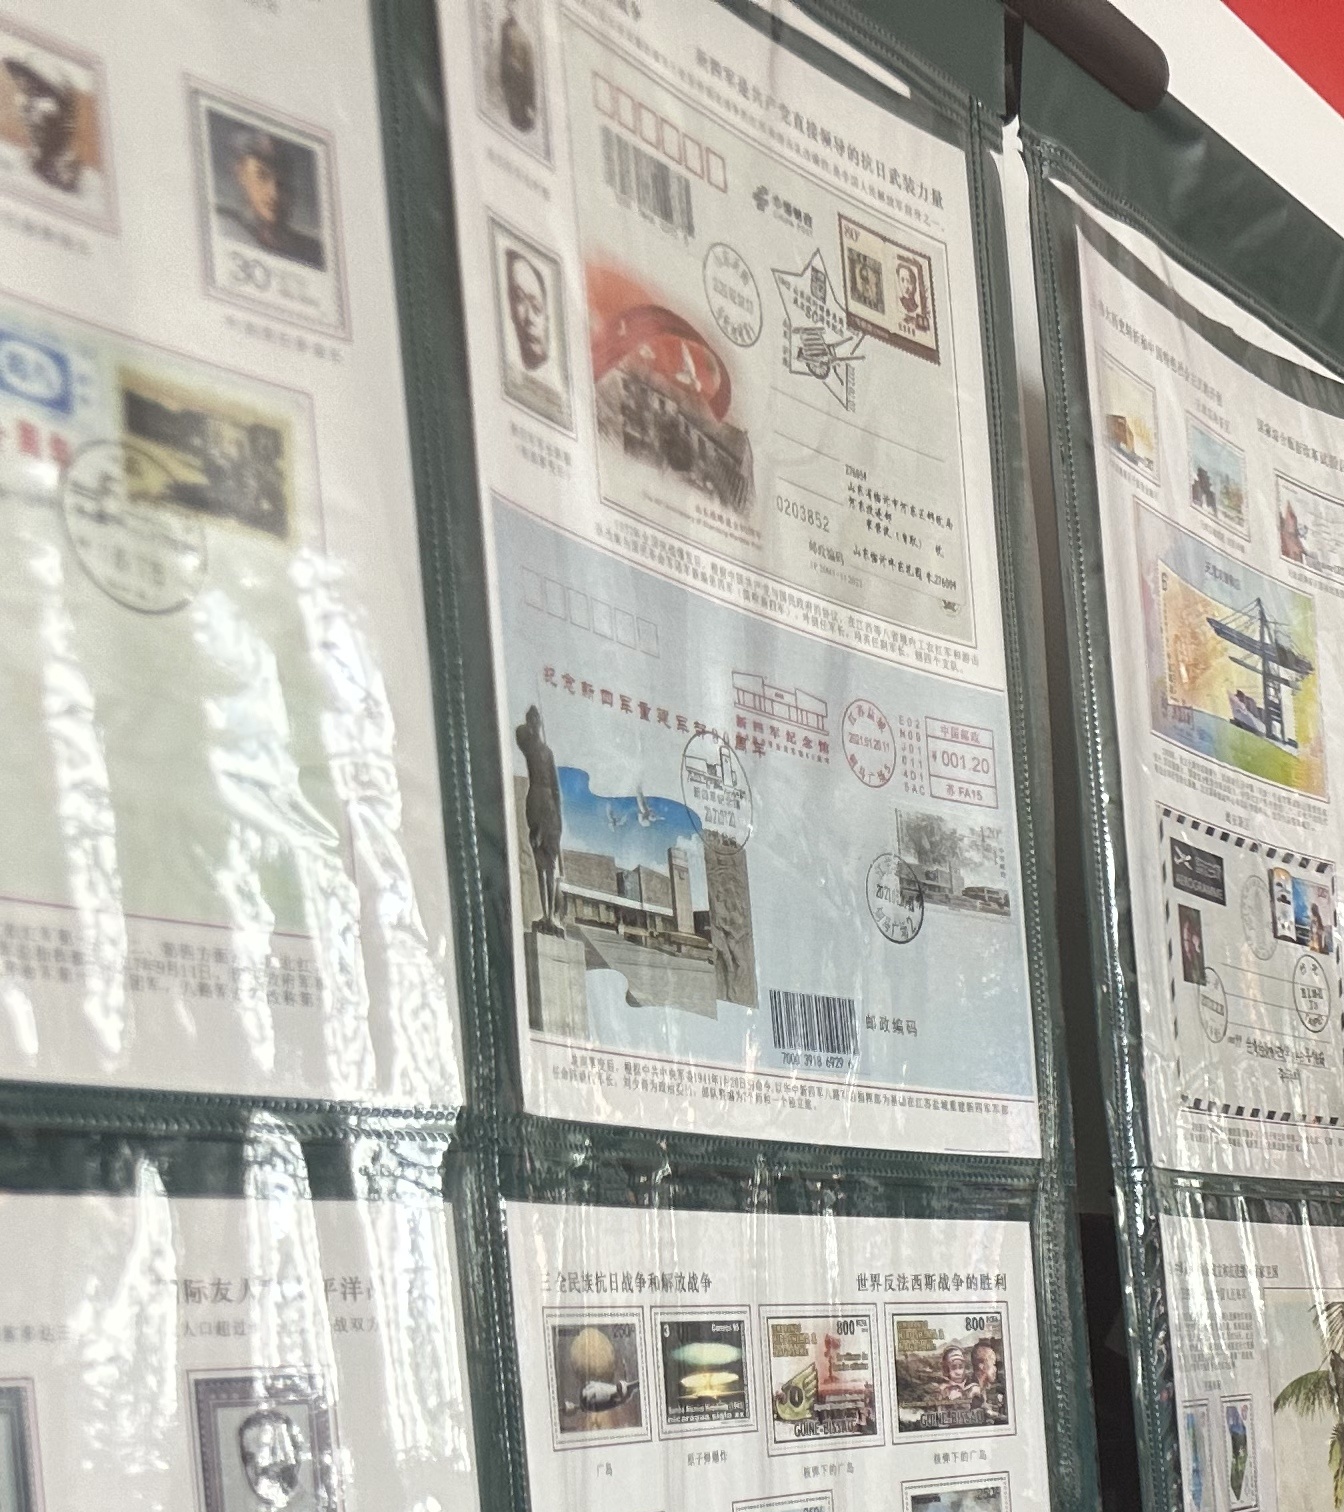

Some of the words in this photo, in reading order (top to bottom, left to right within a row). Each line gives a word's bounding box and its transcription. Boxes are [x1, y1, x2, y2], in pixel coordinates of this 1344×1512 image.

[776, 495, 831, 534] 0203852
[864, 1013, 919, 1037] 邮政编码
[855, 1272, 1008, 1295] 世界反法西斯战争的胜利
[836, 1319, 855, 1337] 800
[965, 1315, 986, 1331] 800
